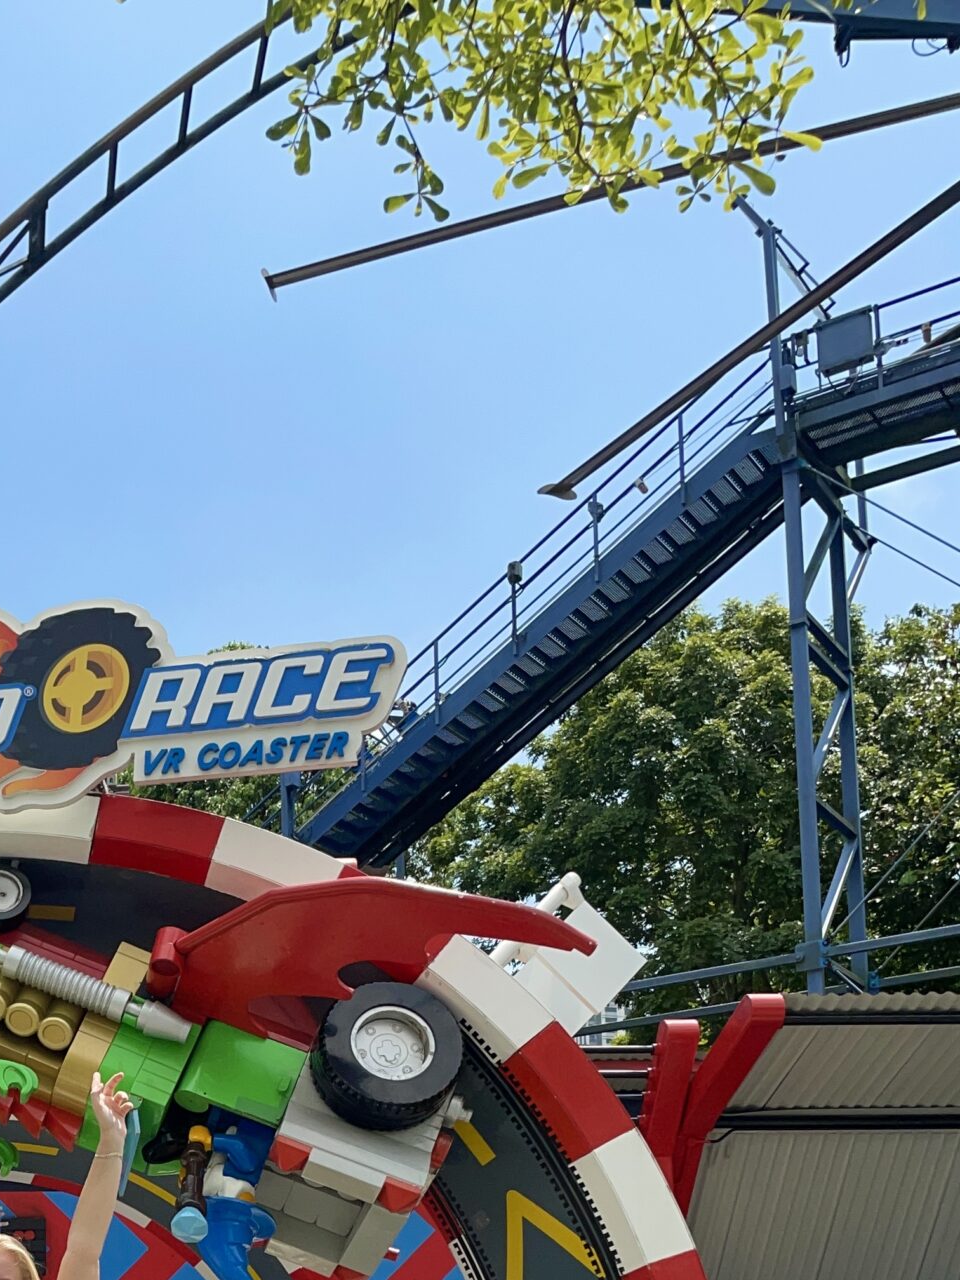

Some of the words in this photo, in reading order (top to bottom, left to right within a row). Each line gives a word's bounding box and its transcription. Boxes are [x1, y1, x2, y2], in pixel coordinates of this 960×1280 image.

[129, 648, 388, 732] RACE
[143, 747, 186, 777] VR
[197, 731, 350, 772] COASTER
